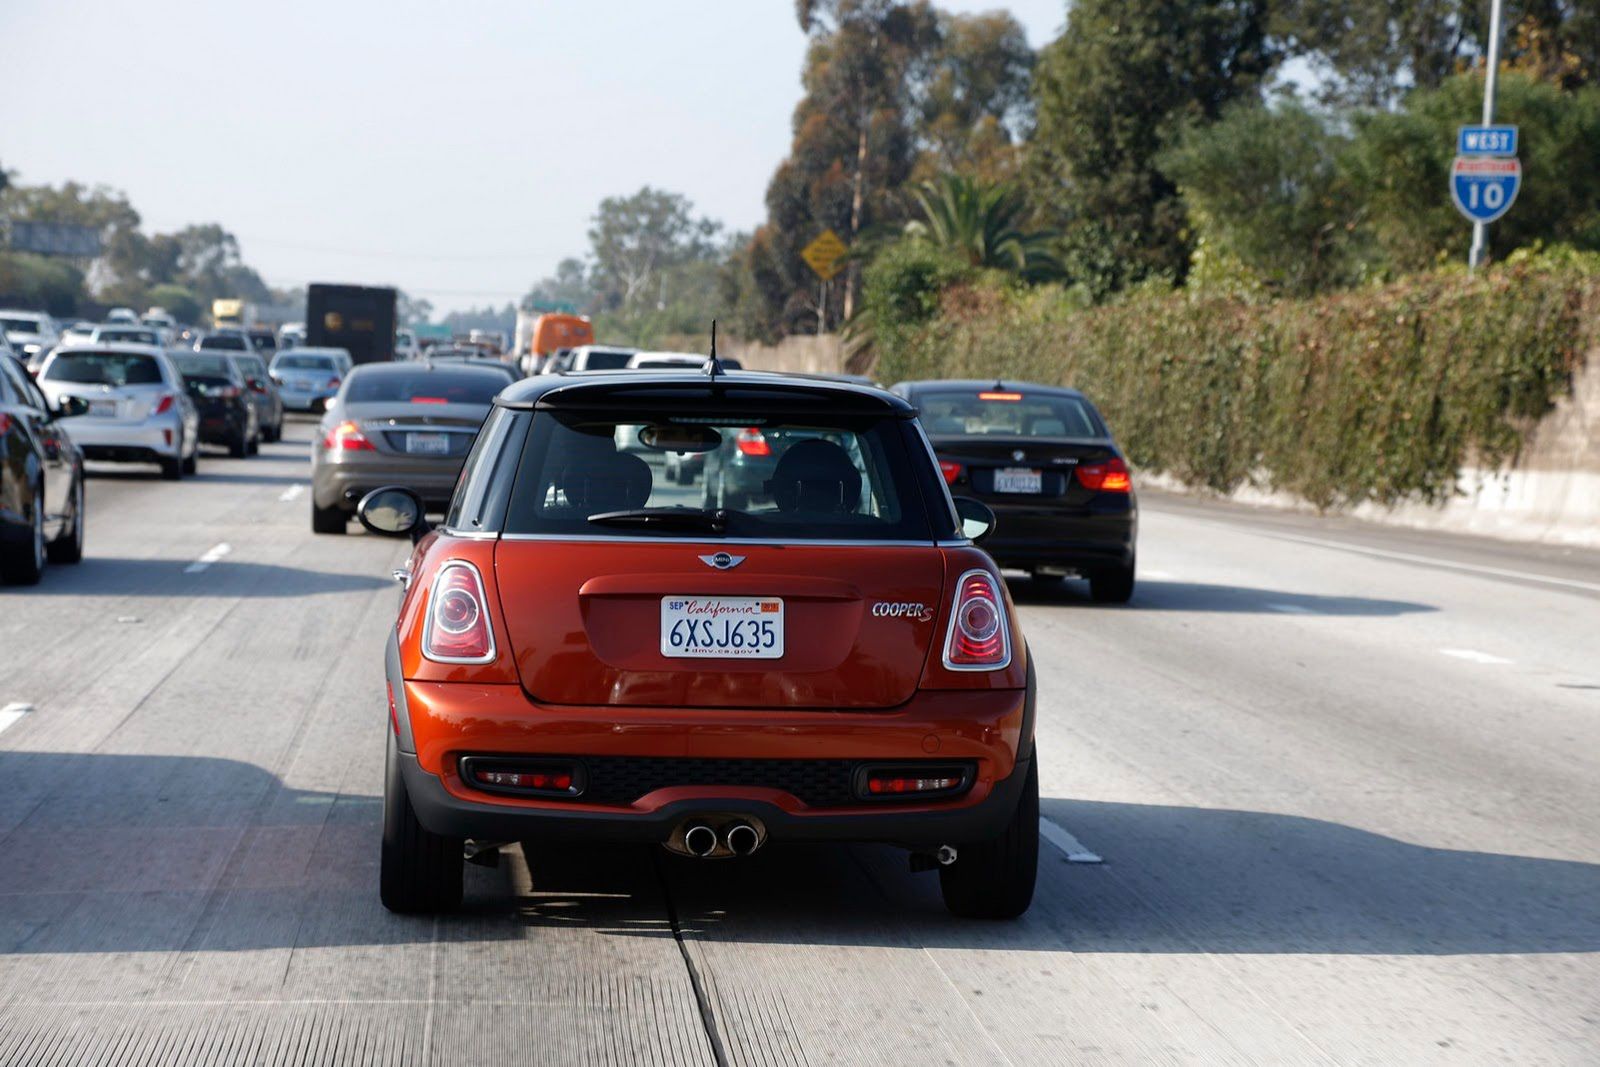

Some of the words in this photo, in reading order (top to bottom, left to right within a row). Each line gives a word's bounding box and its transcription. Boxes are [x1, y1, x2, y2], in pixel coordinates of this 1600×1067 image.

[1465, 131, 1509, 150] WEST
[1469, 183, 1504, 209] 10
[669, 601, 684, 610] SEP
[687, 600, 760, 618] California
[872, 602, 924, 617] COOPER
[670, 619, 775, 648] 6XSJ635
